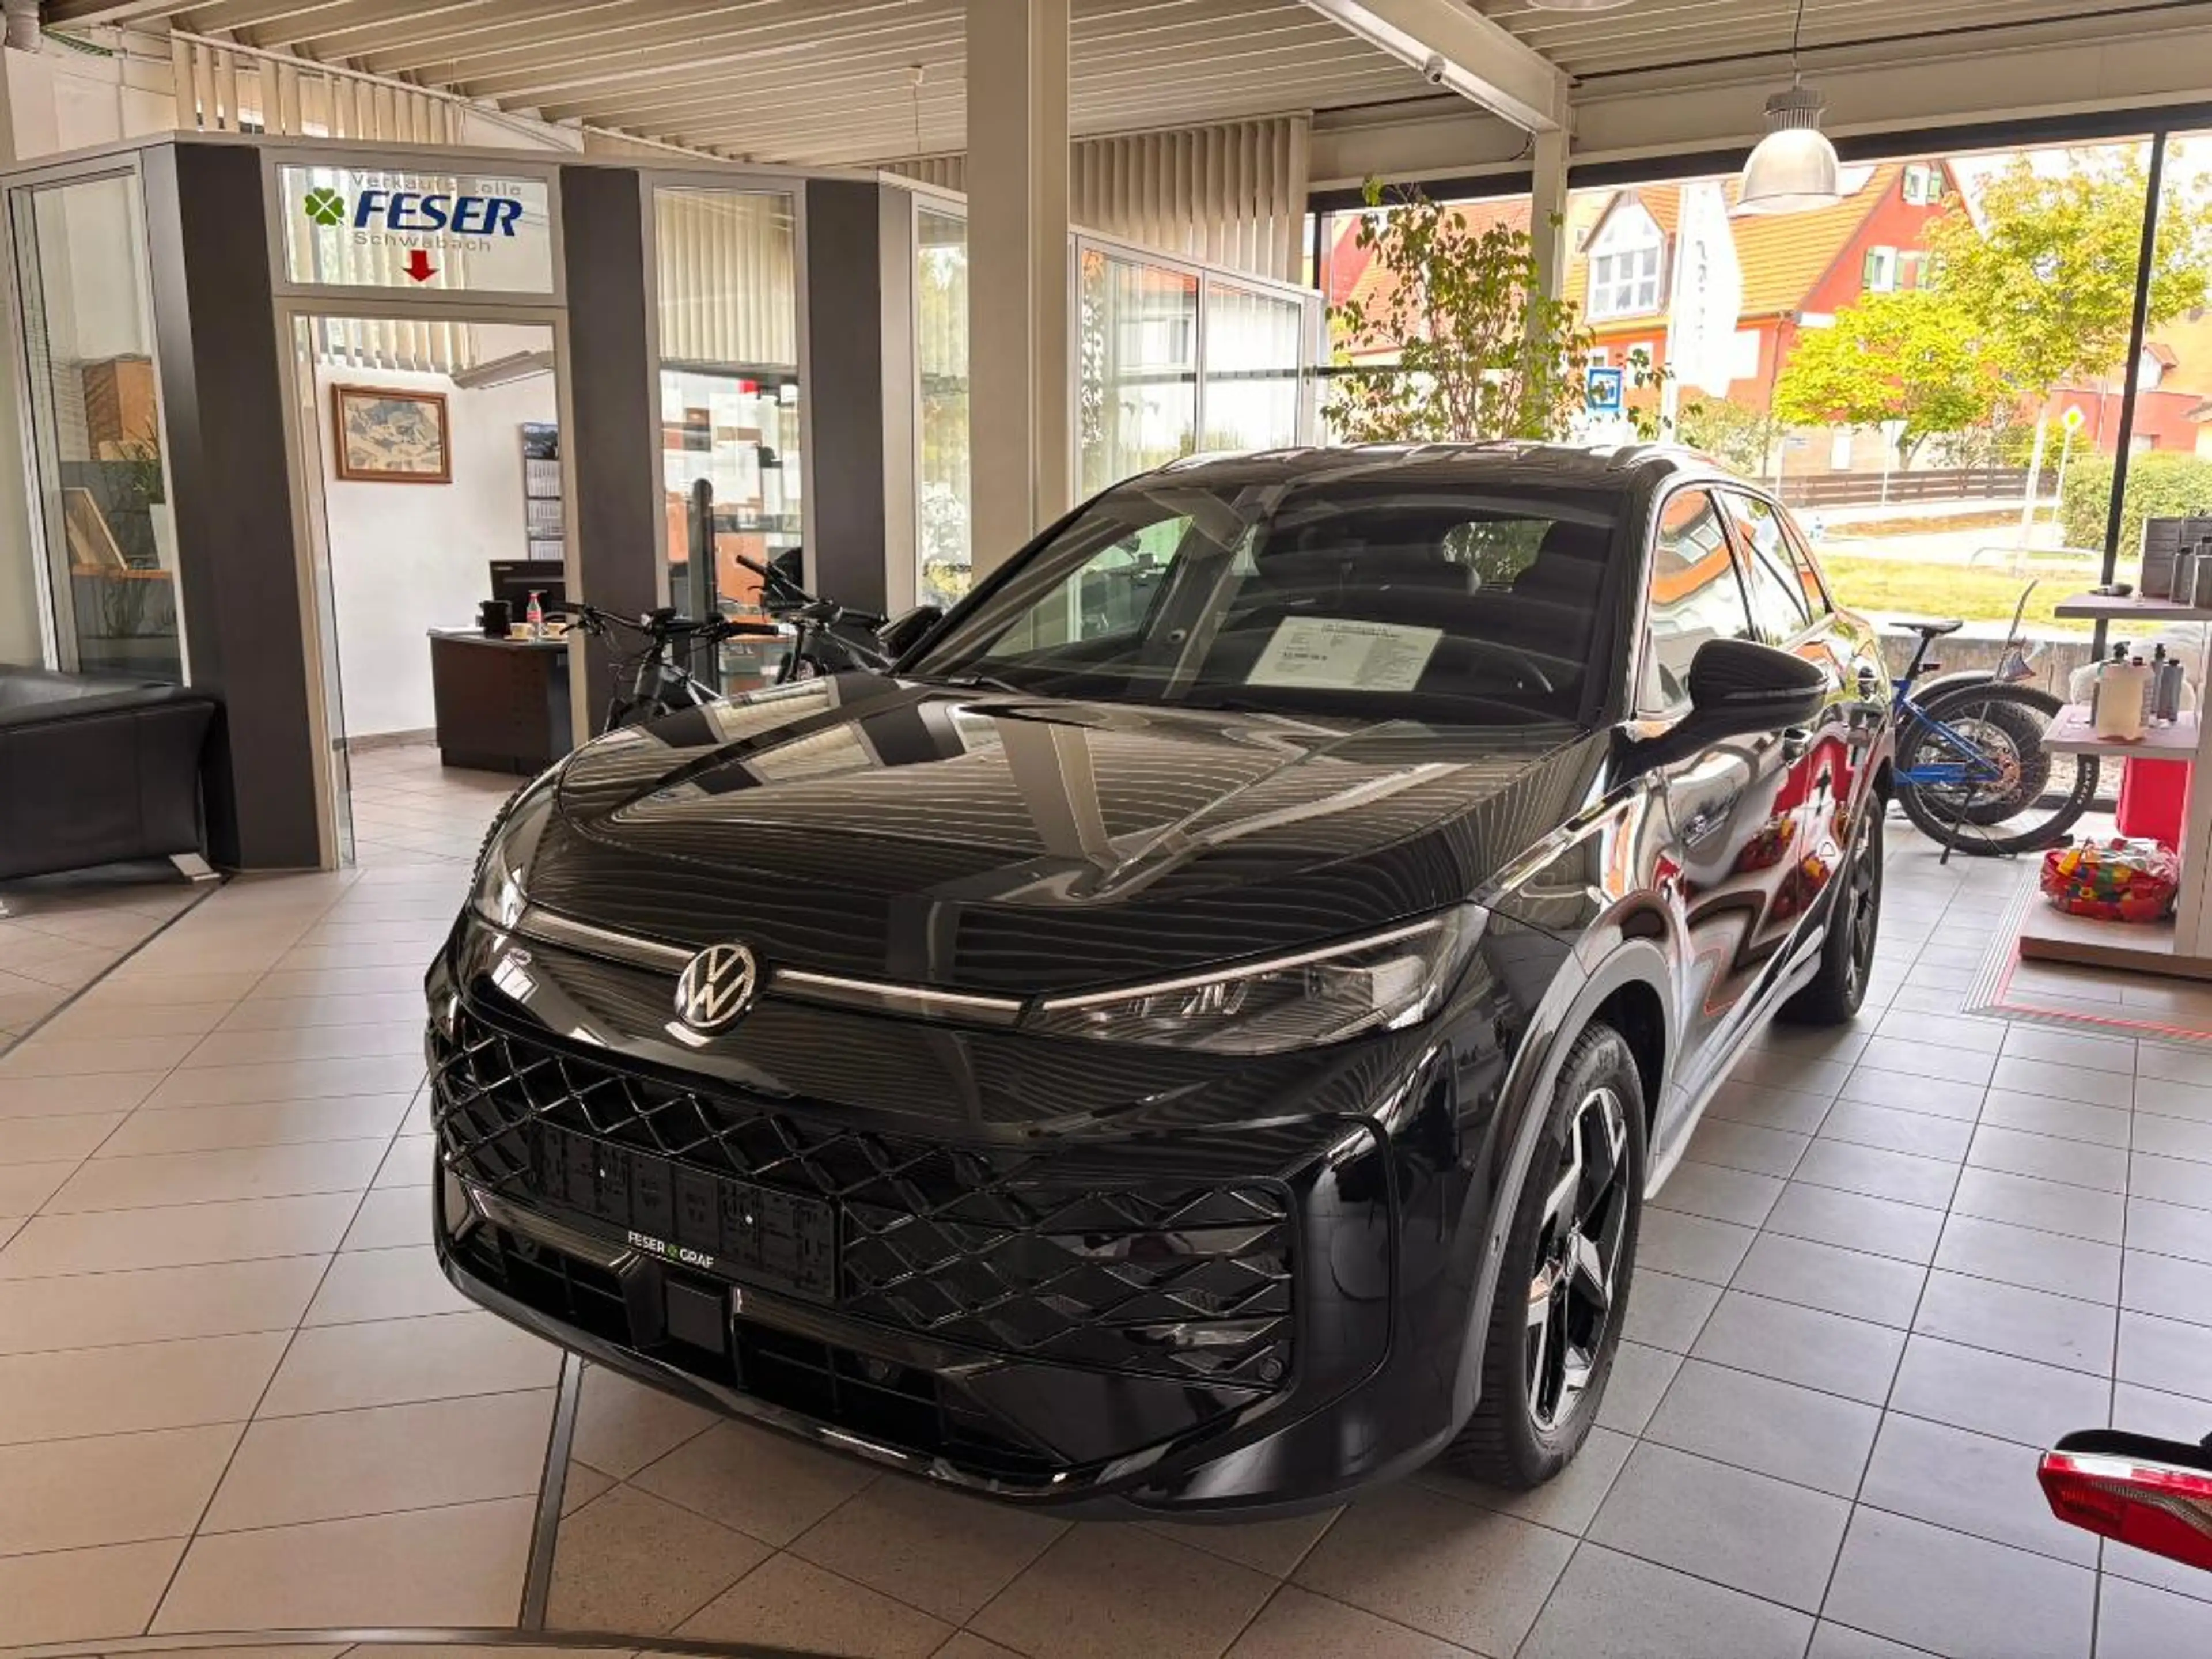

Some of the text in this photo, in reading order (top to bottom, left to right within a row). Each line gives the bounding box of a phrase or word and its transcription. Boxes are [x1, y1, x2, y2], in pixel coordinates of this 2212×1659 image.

[354, 190, 523, 237] FESER
[354, 231, 491, 252] Schwabach
[684, 946, 751, 1024] VW
[628, 1230, 715, 1269] FESER GRAF
